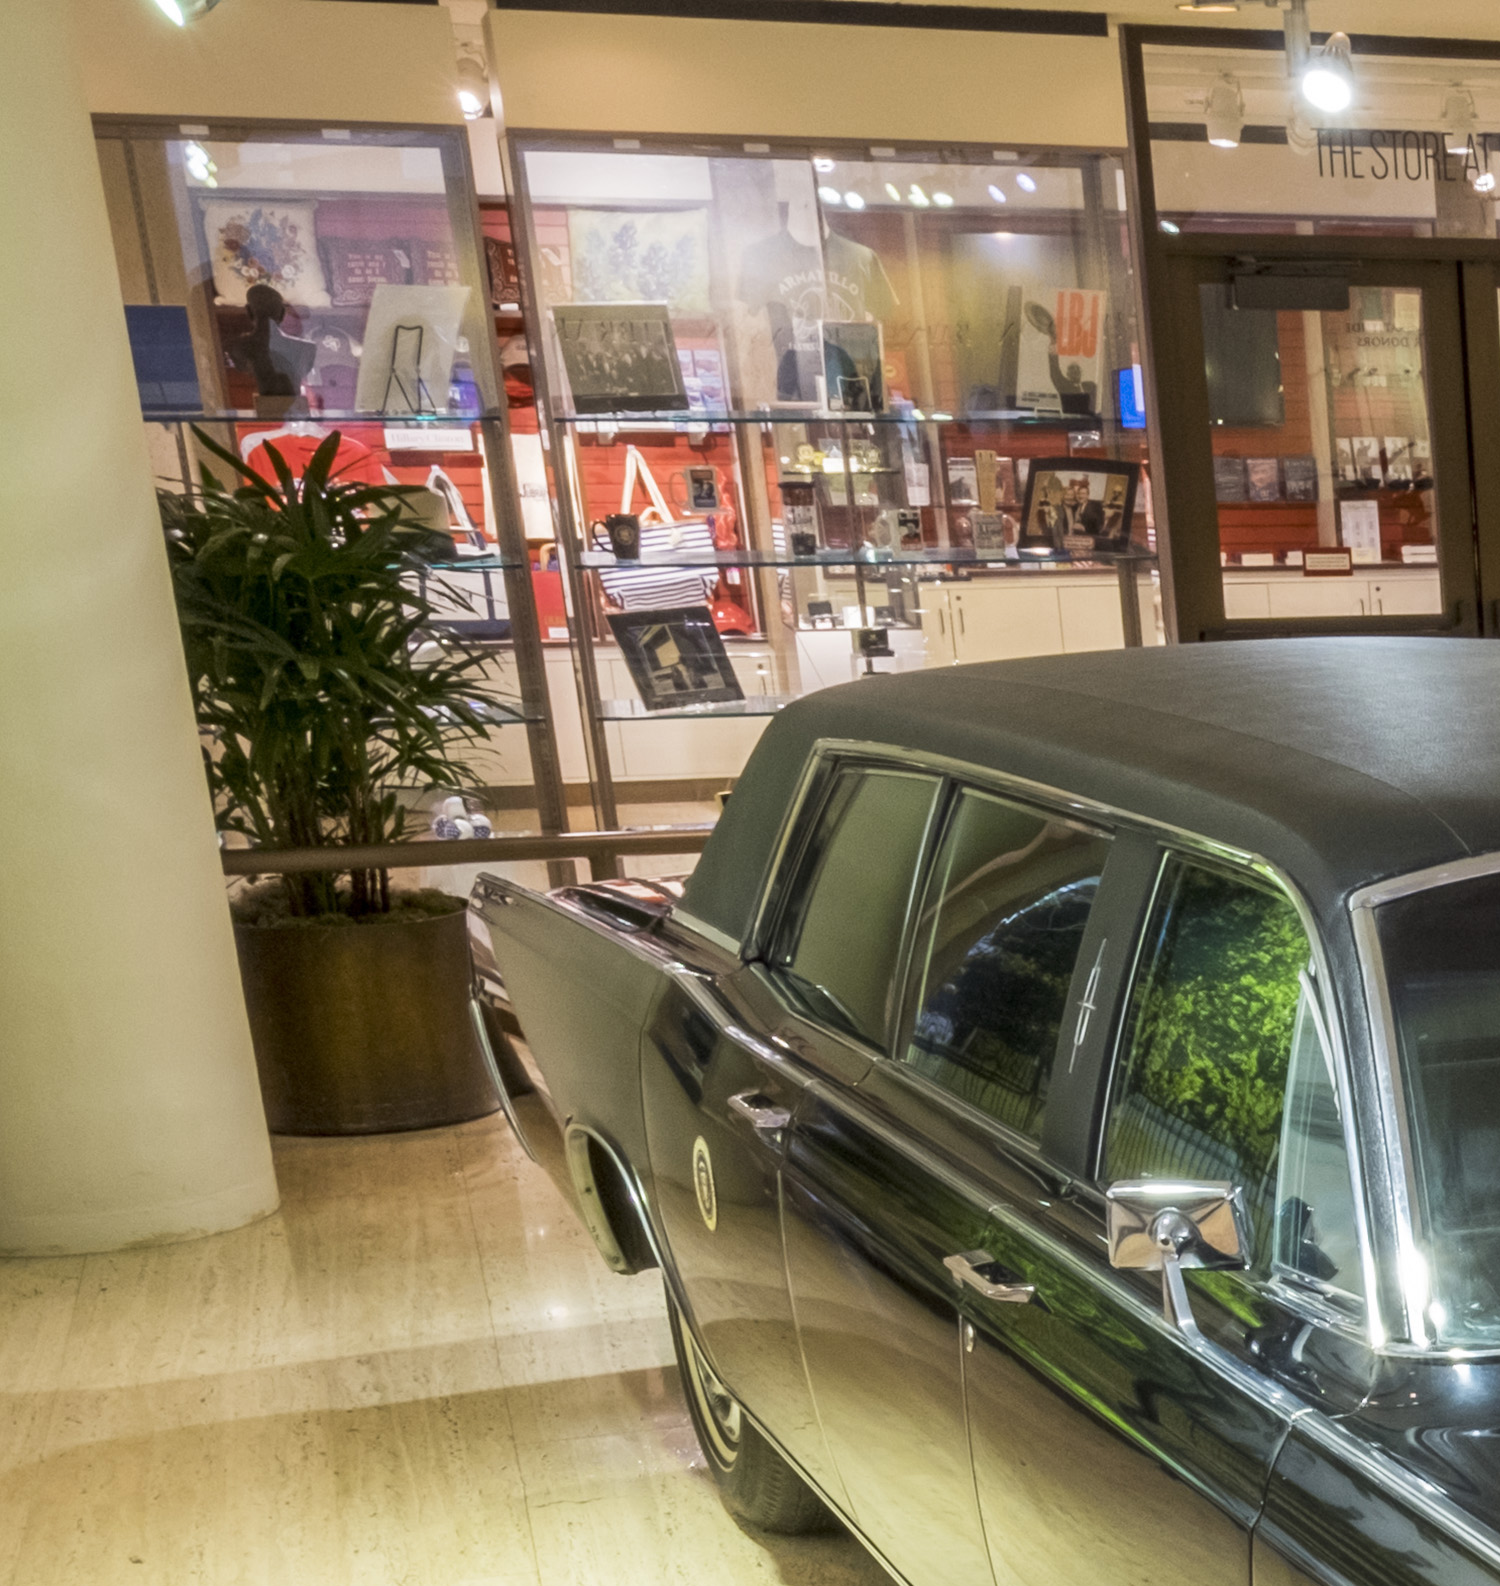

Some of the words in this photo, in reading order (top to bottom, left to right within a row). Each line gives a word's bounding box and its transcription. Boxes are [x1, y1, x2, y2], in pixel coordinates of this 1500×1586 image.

[1317, 127, 1365, 179] THE
[1370, 130, 1457, 182] STORE
[1464, 132, 1492, 183] AT
[1056, 289, 1099, 358] LBJ
